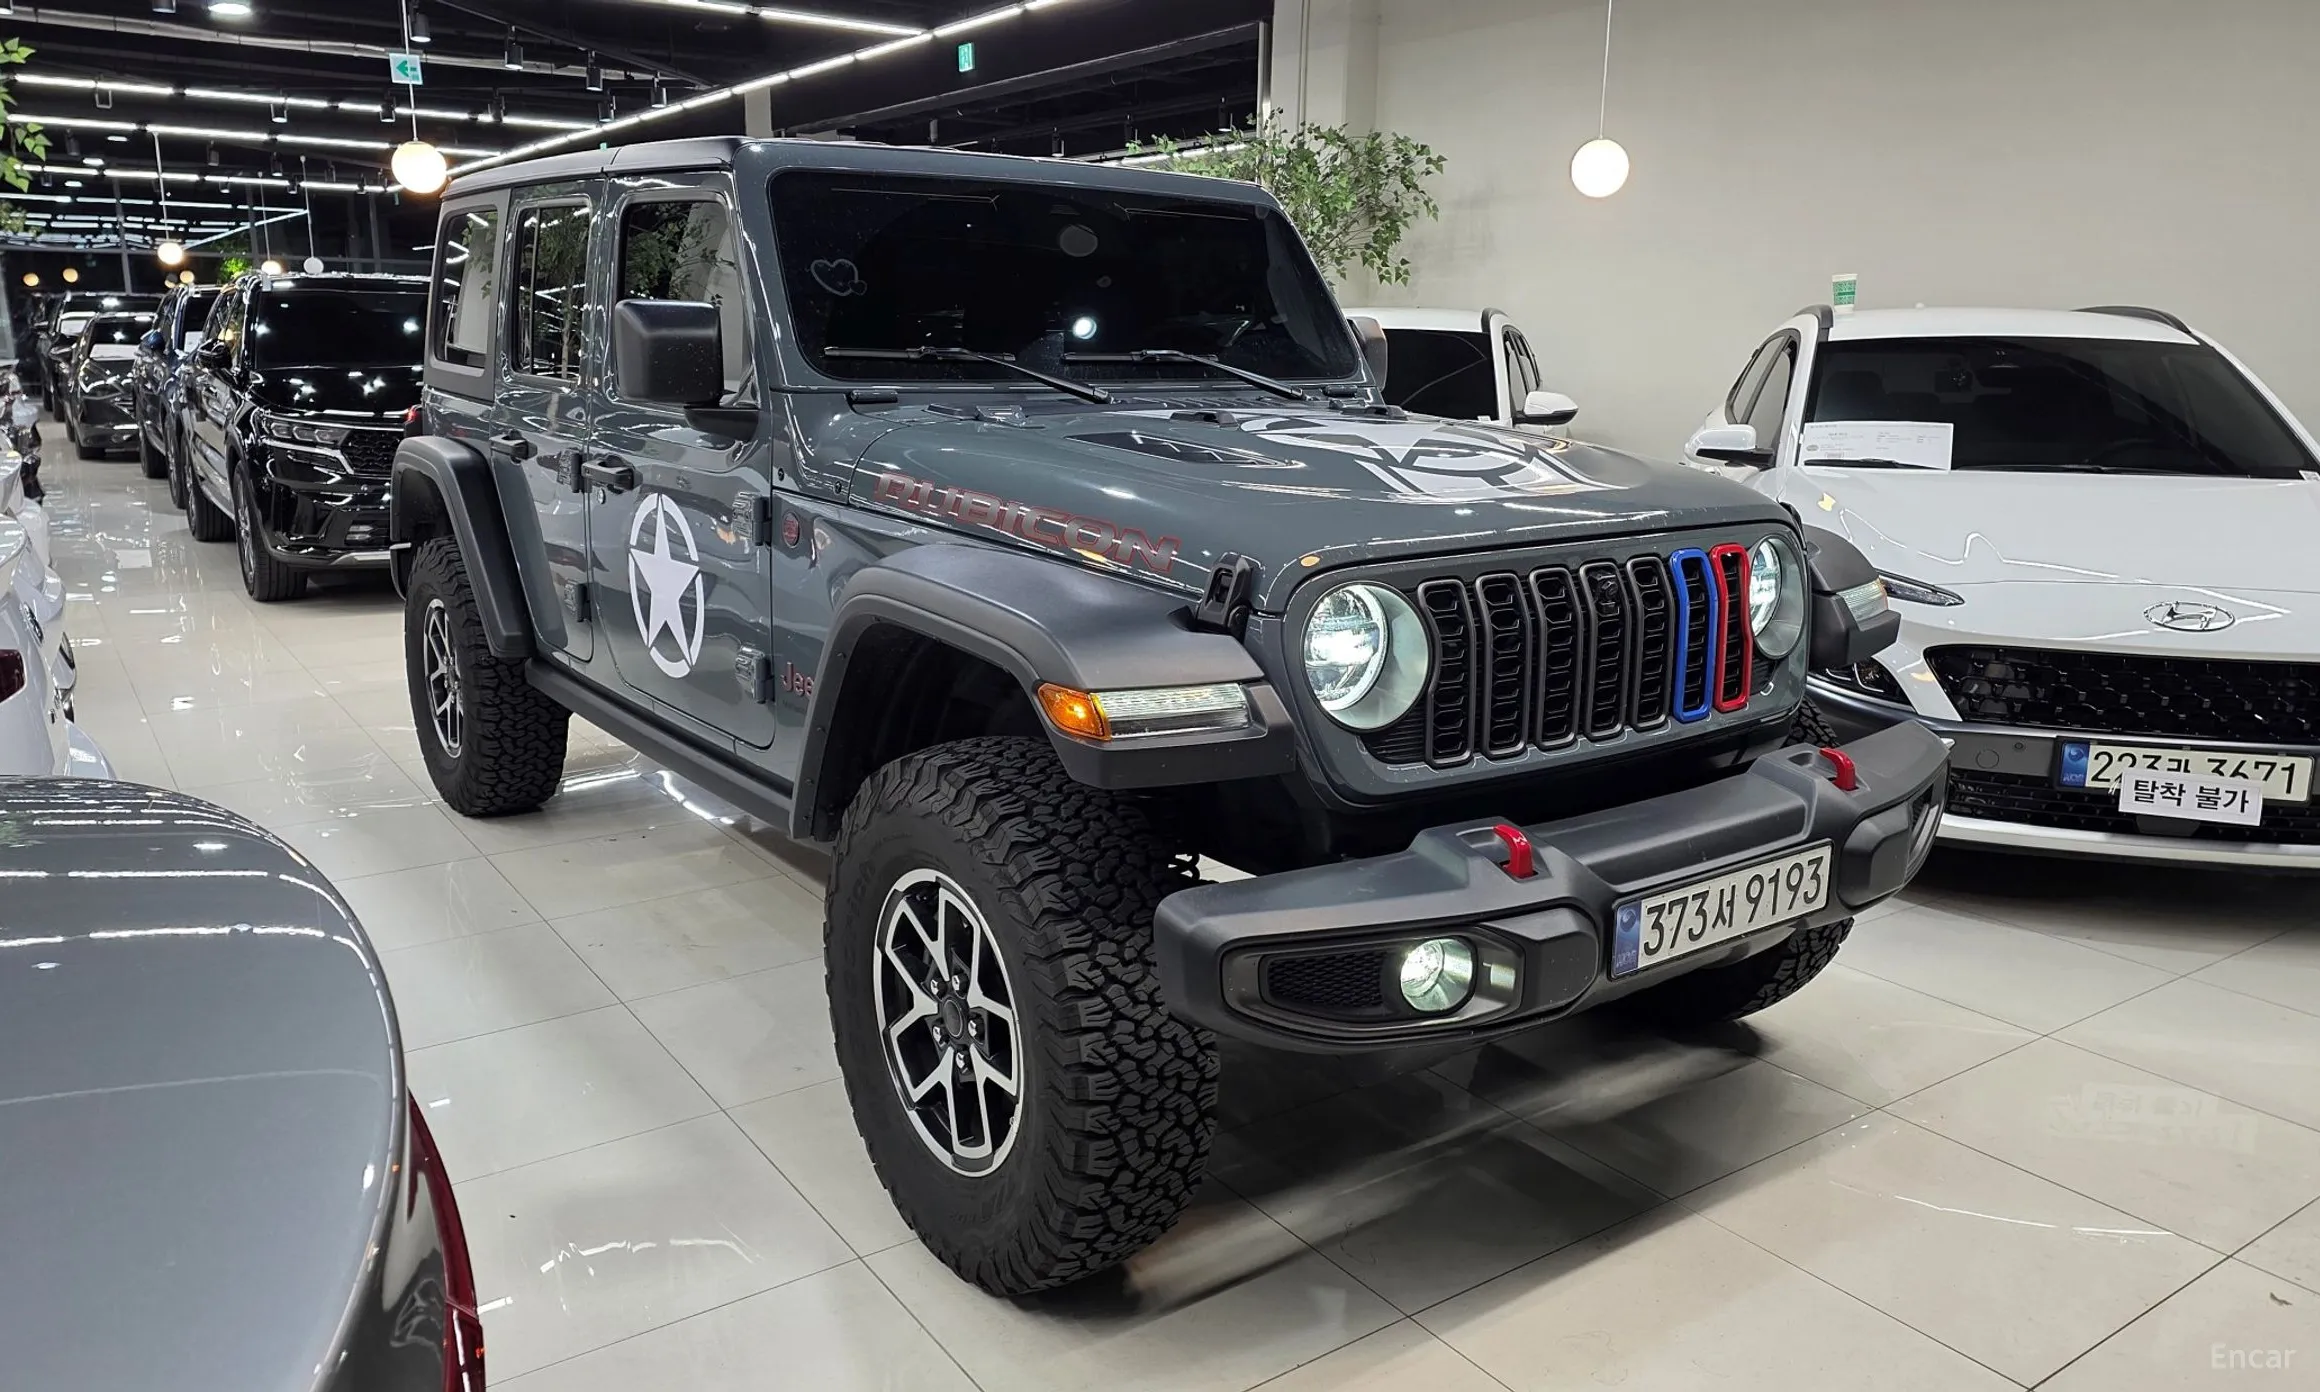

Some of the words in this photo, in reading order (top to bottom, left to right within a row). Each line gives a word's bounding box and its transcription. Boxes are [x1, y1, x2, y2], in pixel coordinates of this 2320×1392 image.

[873, 472, 1181, 573] RUBICON
[780, 661, 815, 700] Jee
[2133, 779, 2186, 807] 탈착
[2195, 785, 2250, 814] 불가
[1643, 884, 1736, 956] 373서
[1745, 855, 1824, 924] 9193
